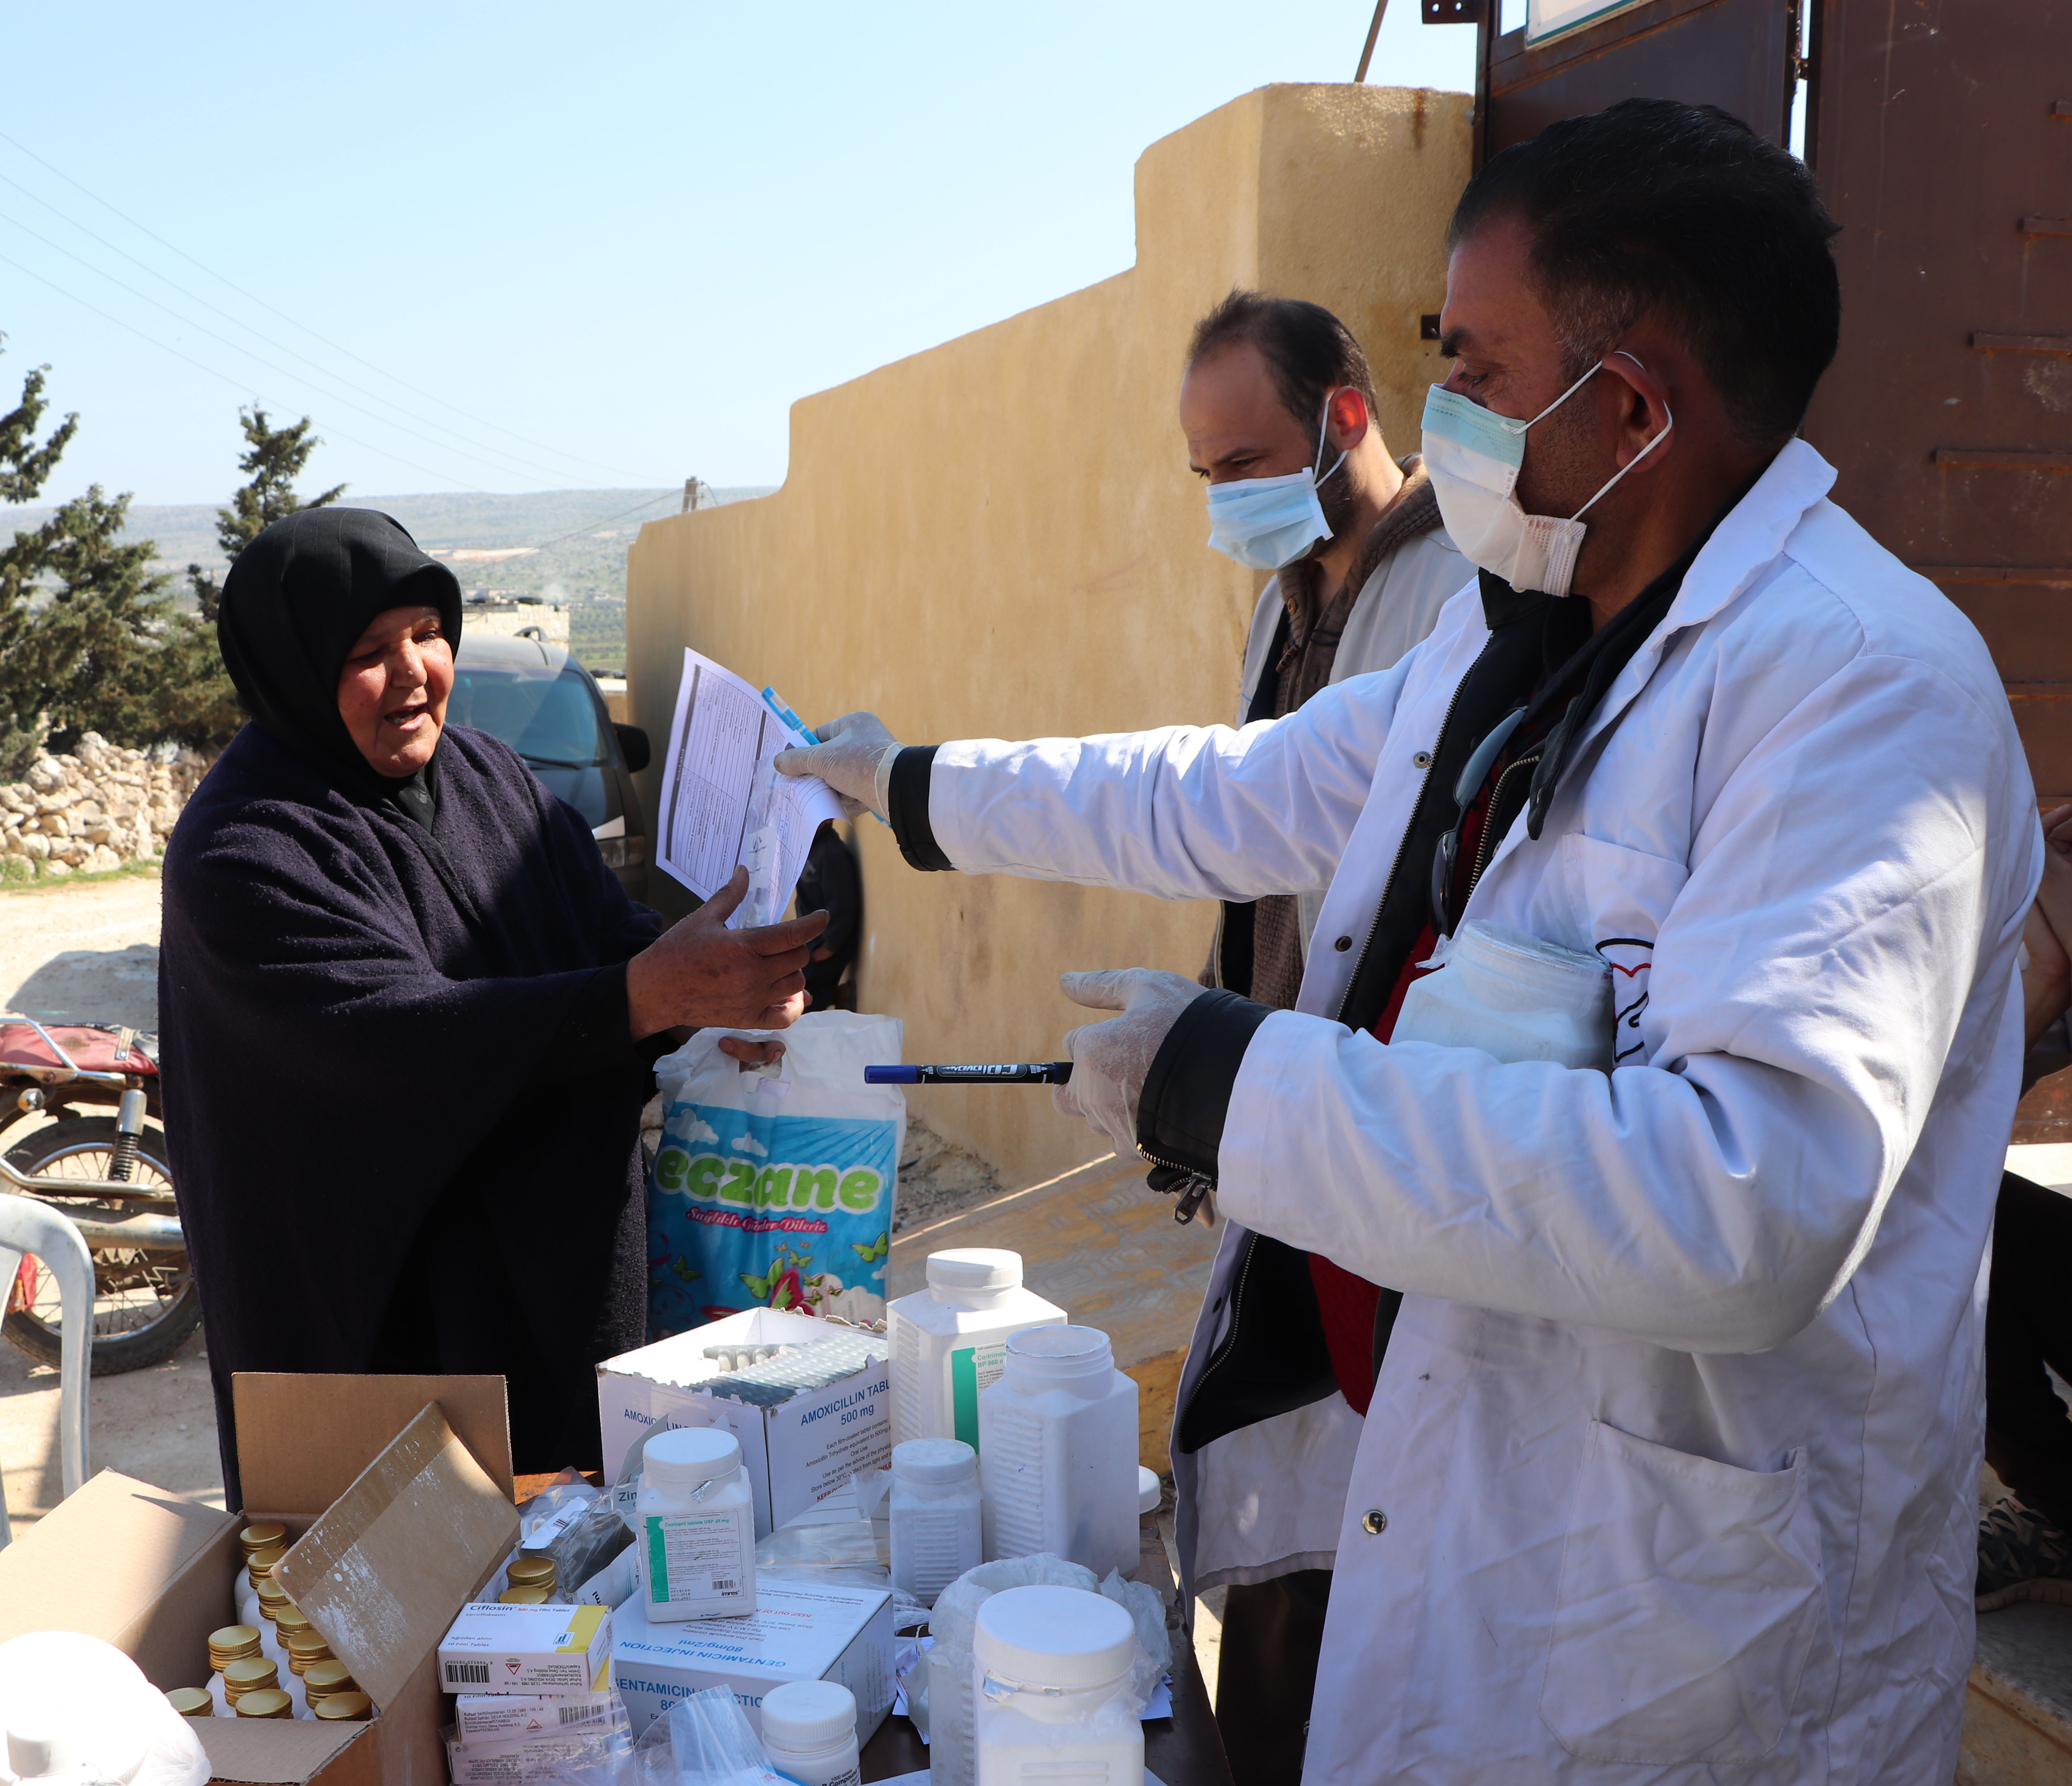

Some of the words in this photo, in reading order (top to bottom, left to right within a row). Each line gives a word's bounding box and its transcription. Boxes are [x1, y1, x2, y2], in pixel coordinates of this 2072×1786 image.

[656, 1149, 880, 1209] eczane
[780, 1218, 828, 1233] Dileriz
[801, 1390, 865, 1426] AMOXICILLIN
[841, 1409, 857, 1425] 500
[860, 1404, 874, 1417] mg
[827, 1442, 837, 1450] Each
[838, 1431, 860, 1444] film-coated
[860, 1426, 871, 1435] tablet
[806, 1455, 828, 1468] Amoxicillin
[828, 1445, 848, 1458] Trihydrate
[849, 1435, 869, 1448] equivalent
[874, 1427, 888, 1438] 500mg
[850, 1448, 859, 1456] Oral
[852, 1455, 865, 1465] advice
[811, 1484, 823, 1493] Store
[823, 1479, 835, 1488] below
[862, 1461, 872, 1471] from
[872, 1456, 881, 1465] light
[881, 1452, 889, 1460] and
[732, 1630, 767, 1638] Gentamicin
[621, 1641, 695, 1657] INJECTION
[678, 1639, 743, 1653] 80mg/2ml
[698, 1651, 786, 1667] GENTAMICIN
[841, 1769, 852, 1778] tablets
